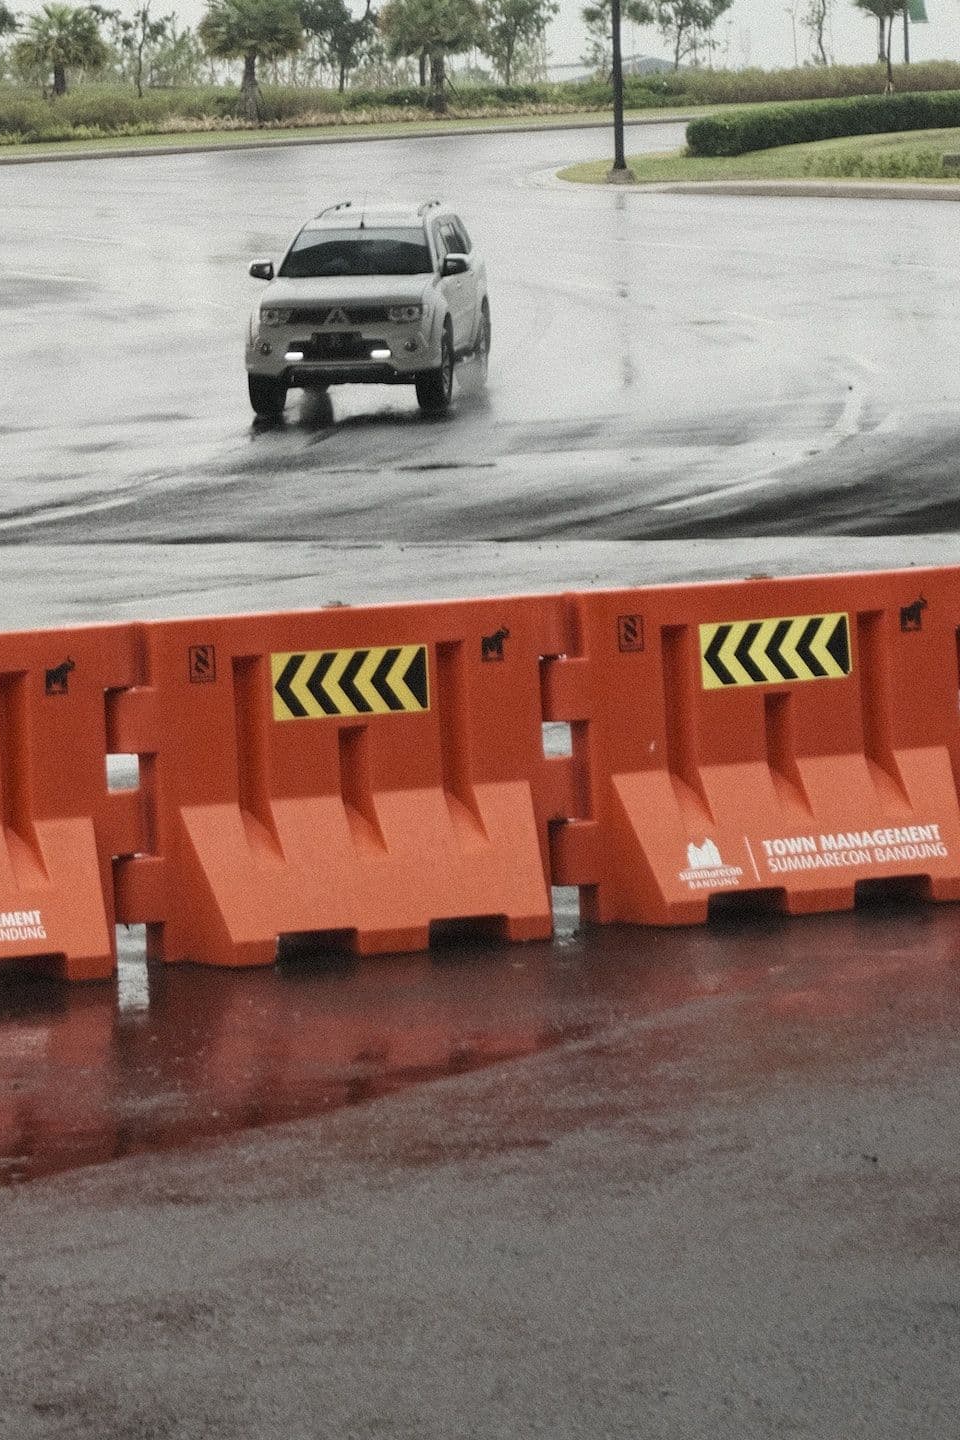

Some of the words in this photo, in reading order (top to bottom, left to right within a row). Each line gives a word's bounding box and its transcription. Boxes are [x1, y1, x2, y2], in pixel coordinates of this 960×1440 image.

[762, 836, 817, 857] TOWN
[819, 824, 941, 851] MANAGEMENT
[768, 849, 872, 873] SUMMARECON
[874, 843, 948, 863] BANDUNG
[679, 866, 743, 880] summarecon
[688, 877, 739, 889] BANDUNG
